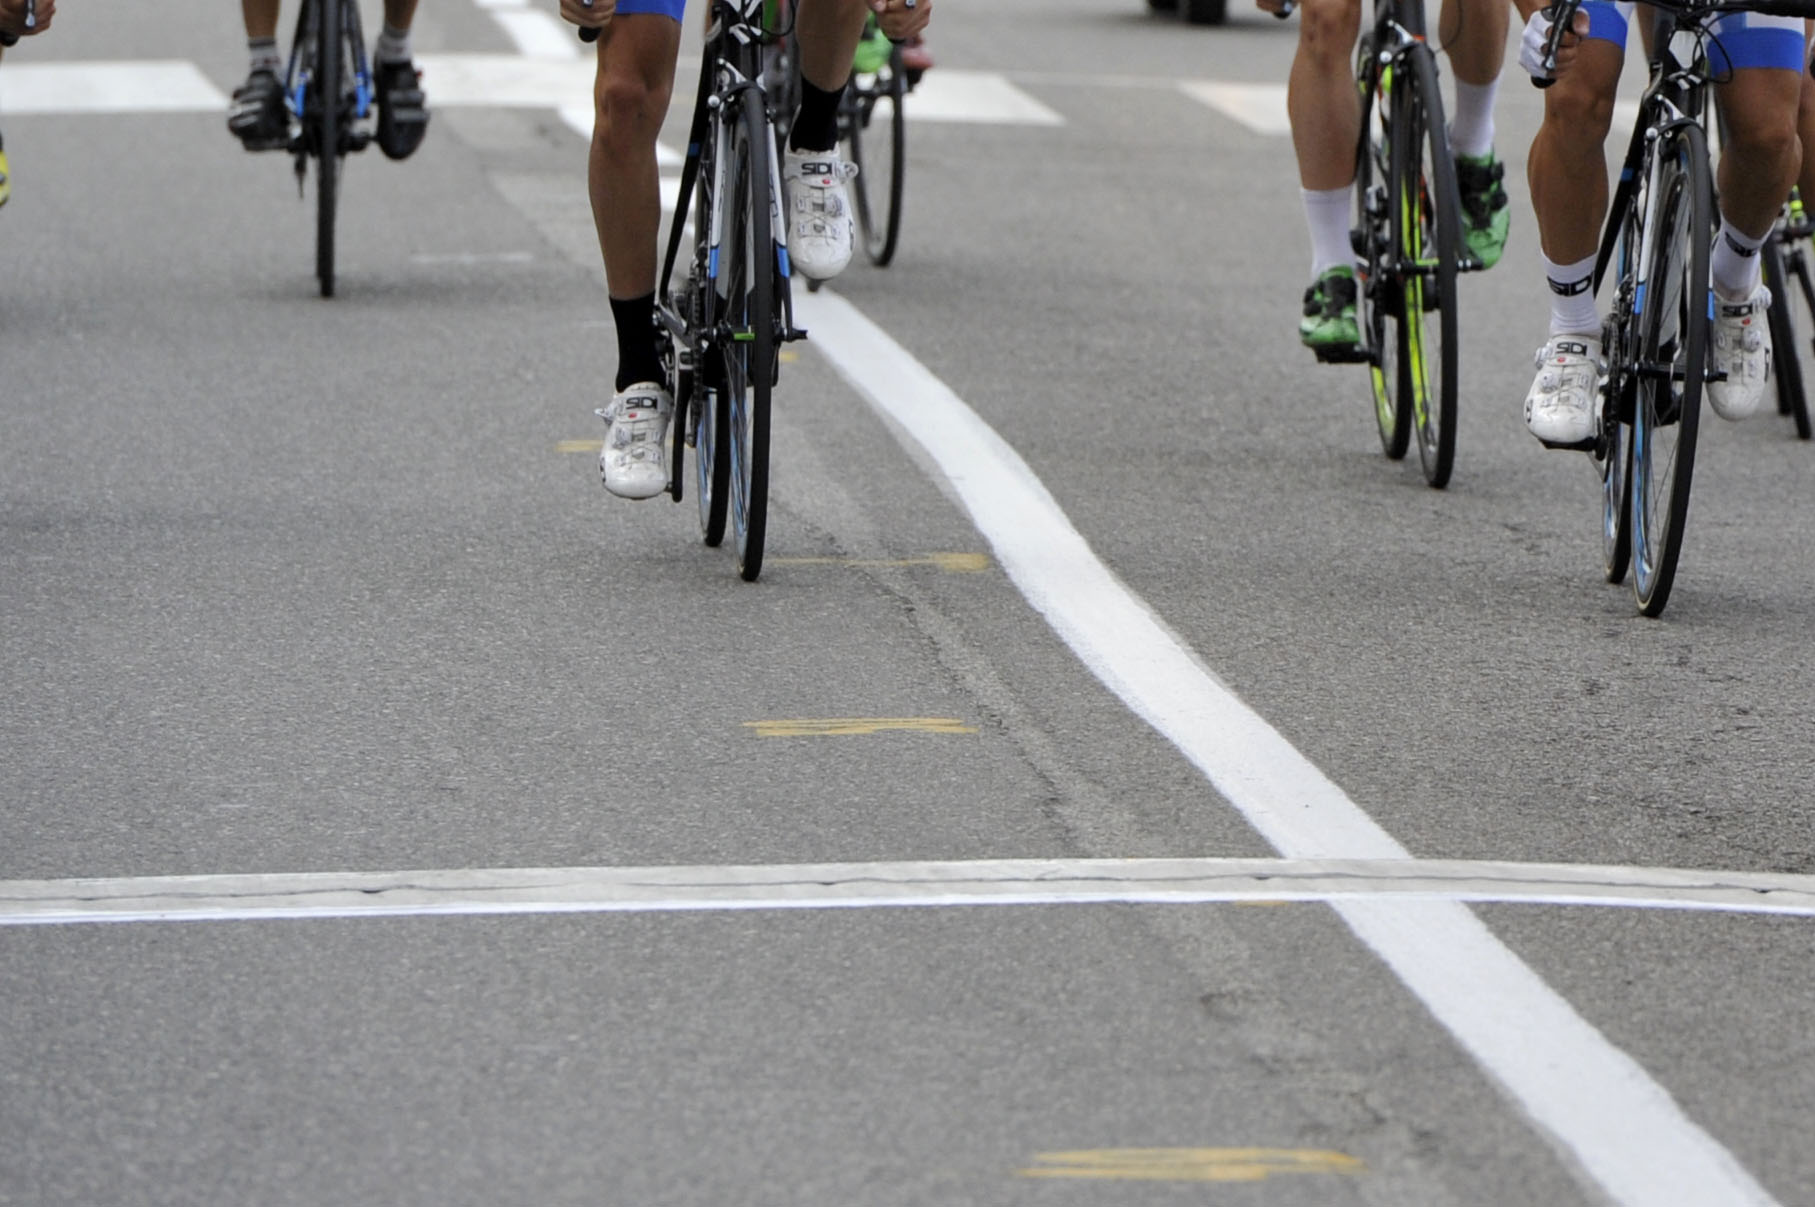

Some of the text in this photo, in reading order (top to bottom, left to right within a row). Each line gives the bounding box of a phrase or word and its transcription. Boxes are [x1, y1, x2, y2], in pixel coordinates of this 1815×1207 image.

[801, 163, 832, 176] SIDI
[1555, 341, 1588, 357] SIDI
[625, 396, 658, 410] SIDI
